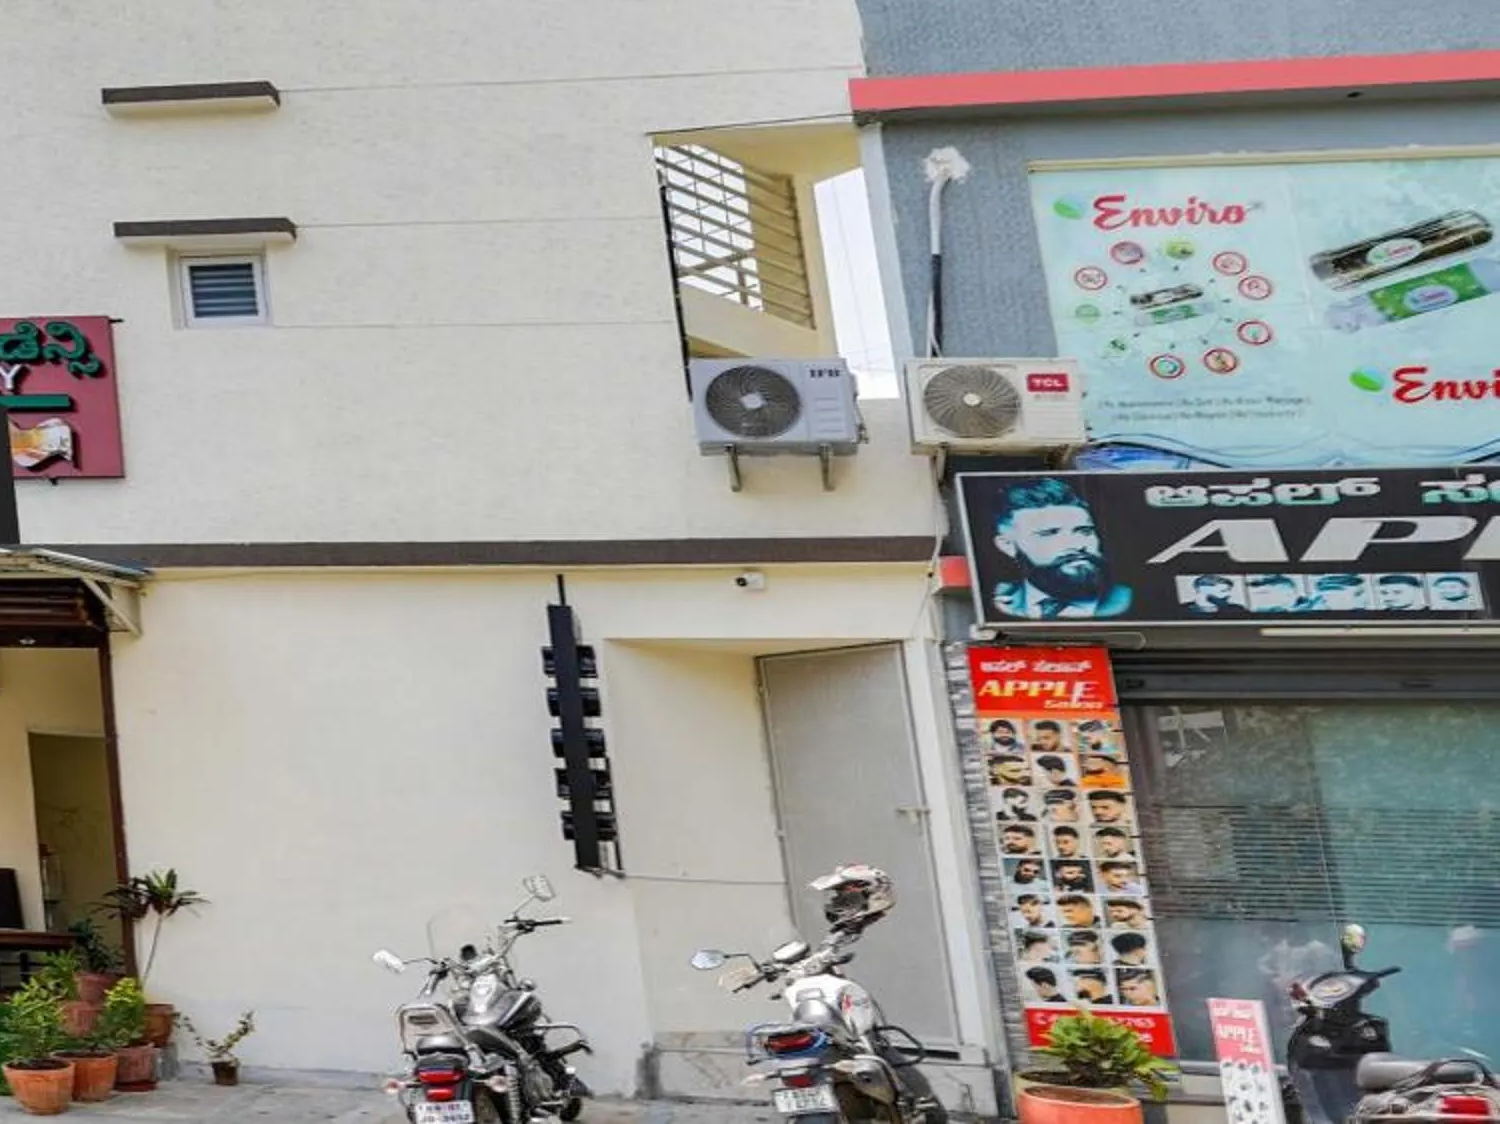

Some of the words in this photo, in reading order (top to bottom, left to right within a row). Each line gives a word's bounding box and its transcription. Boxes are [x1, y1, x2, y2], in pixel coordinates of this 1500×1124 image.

[1092, 195, 1246, 230] Enviro
[1031, 377, 1065, 388] TCL
[1146, 516, 1500, 564] AP
[978, 679, 1100, 704] APPLE
